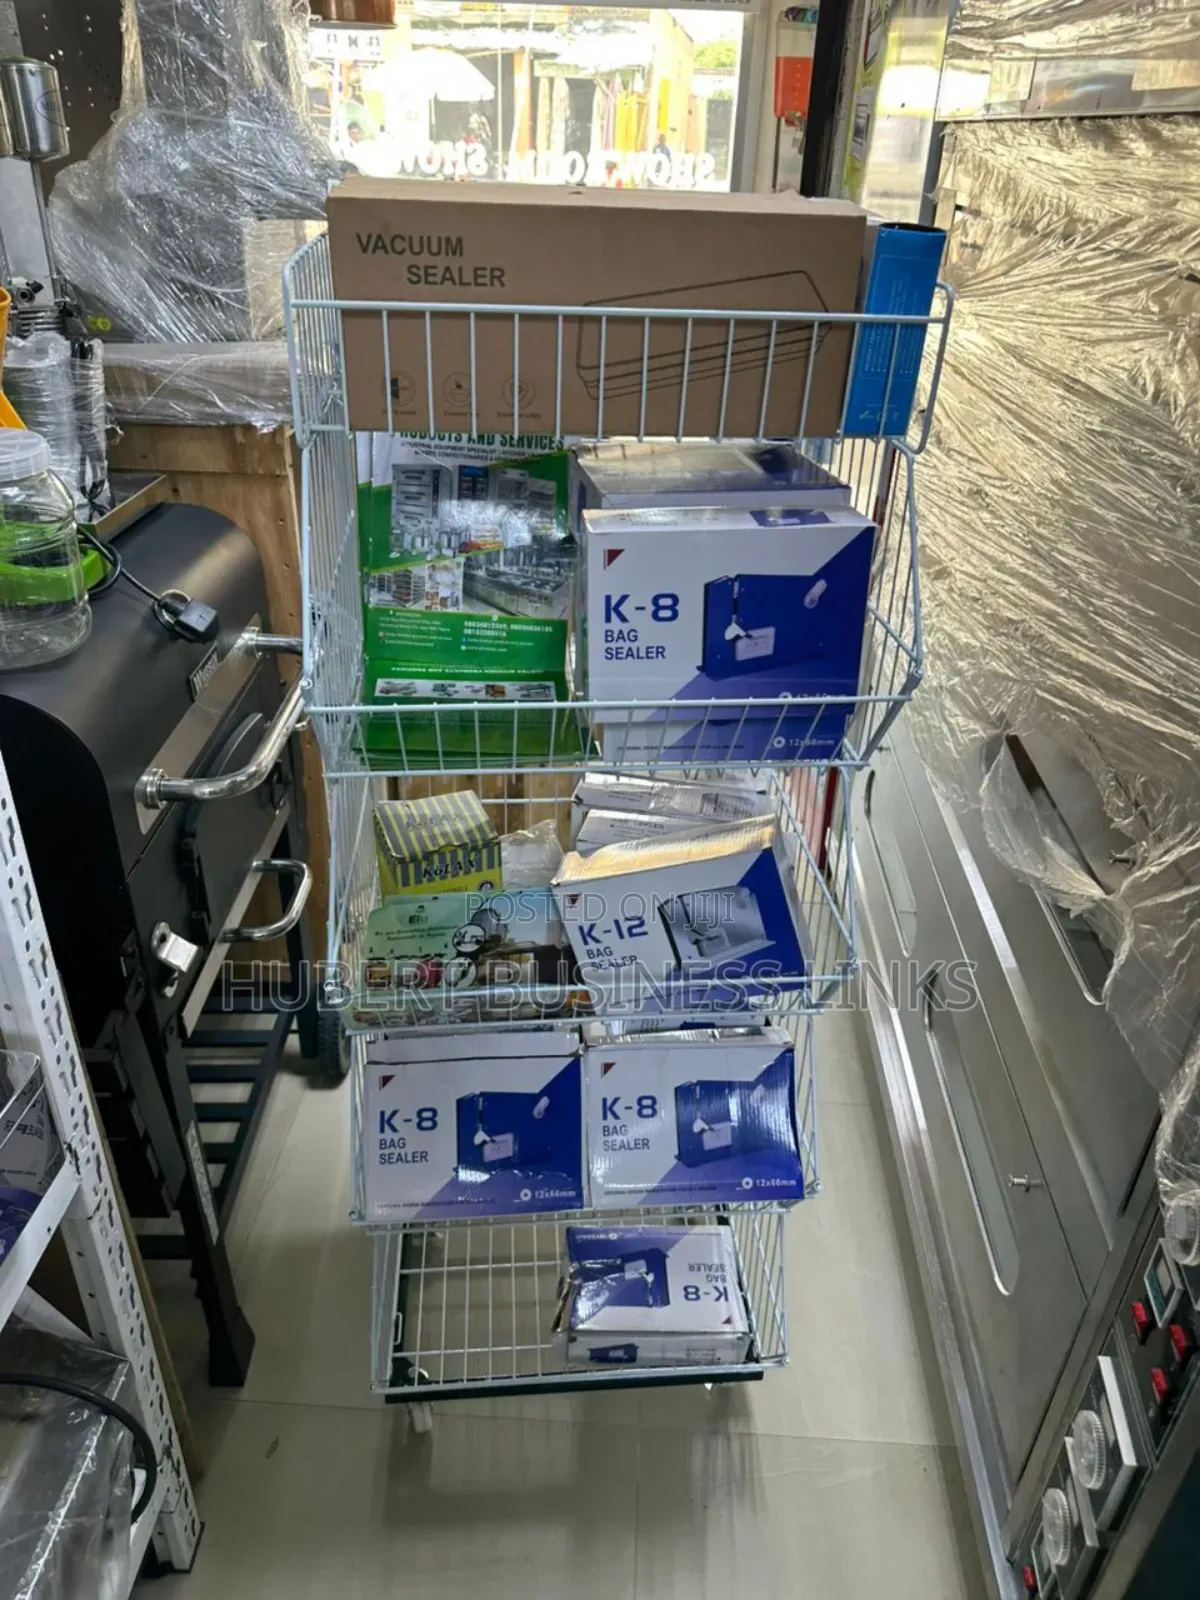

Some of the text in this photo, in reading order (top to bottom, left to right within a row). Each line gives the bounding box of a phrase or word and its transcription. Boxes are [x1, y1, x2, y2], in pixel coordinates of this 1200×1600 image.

[355, 233, 464, 257] VACUUM
[406, 264, 506, 287] SEALER
[604, 593, 680, 623] K-8
[604, 628, 639, 643] BAG
[604, 645, 666, 660] SEALER
[578, 916, 649, 946] K-12
[586, 946, 613, 959] BAG
[601, 1095, 658, 1121] K-8
[379, 1107, 438, 1134] K-8
[602, 1124, 628, 1137] BAG
[379, 1137, 407, 1151] BAG
[603, 1137, 651, 1151] SEALER
[379, 1151, 429, 1165] SEALER
[688, 1262, 726, 1273] SEALER
[705, 1273, 726, 1283] BAG
[682, 1285, 730, 1303] K-8
